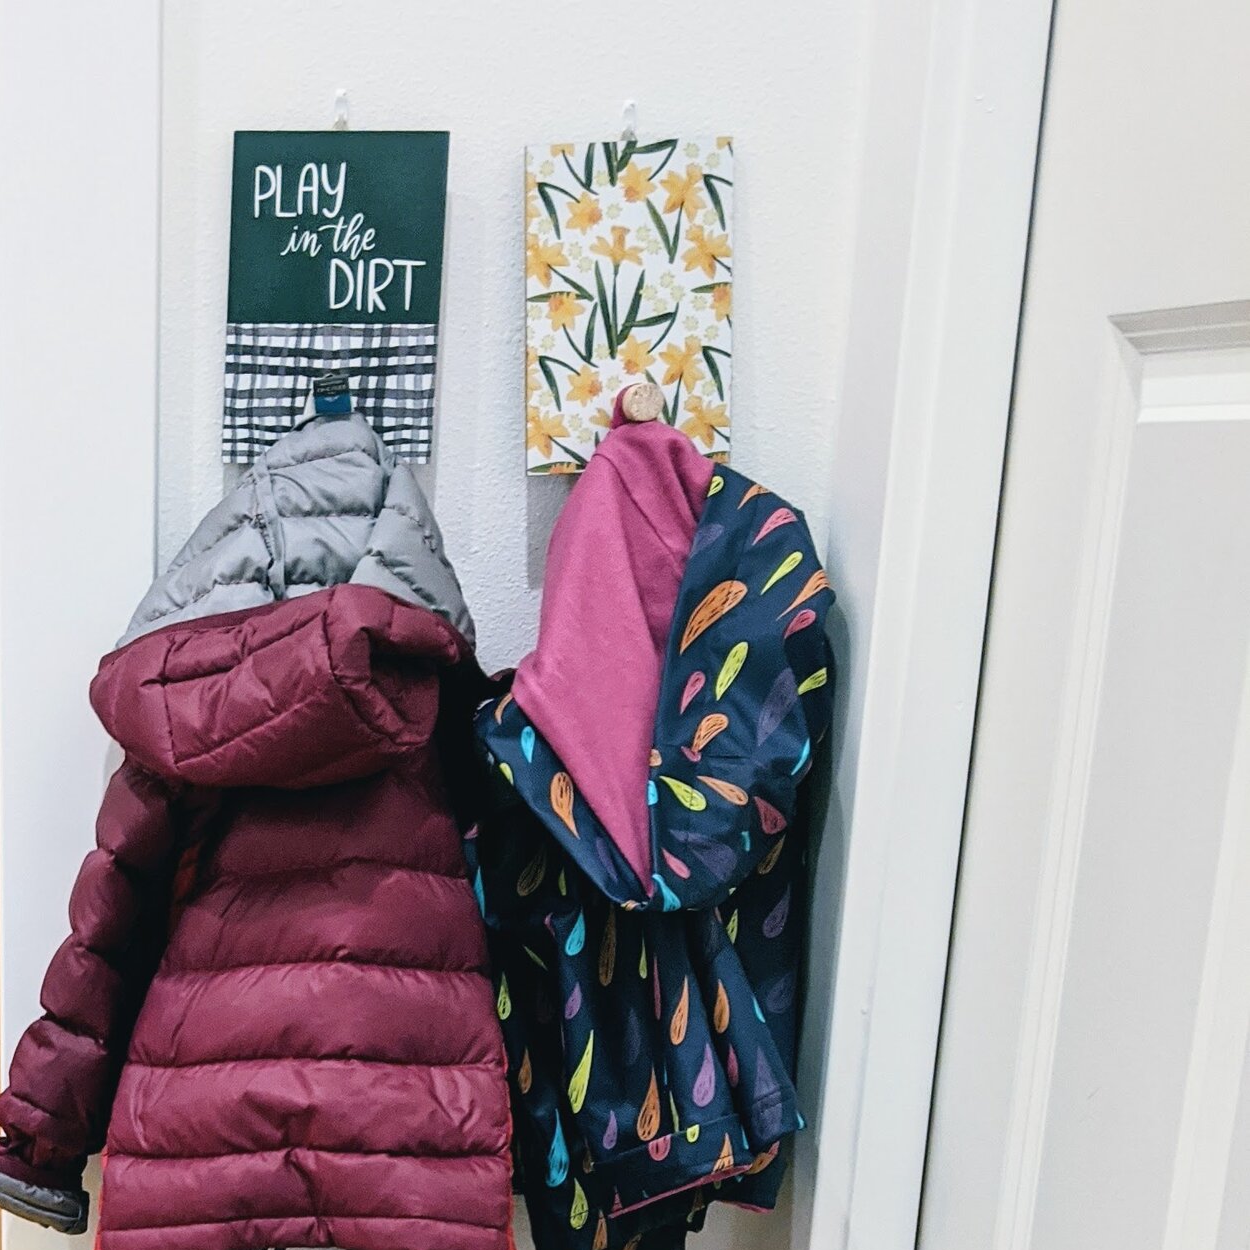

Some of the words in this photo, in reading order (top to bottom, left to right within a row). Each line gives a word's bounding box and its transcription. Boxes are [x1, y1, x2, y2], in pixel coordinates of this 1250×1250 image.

[254, 161, 347, 219] PLAY
[281, 224, 322, 258] in
[318, 213, 376, 260] the
[329, 258, 427, 314] DIRT
